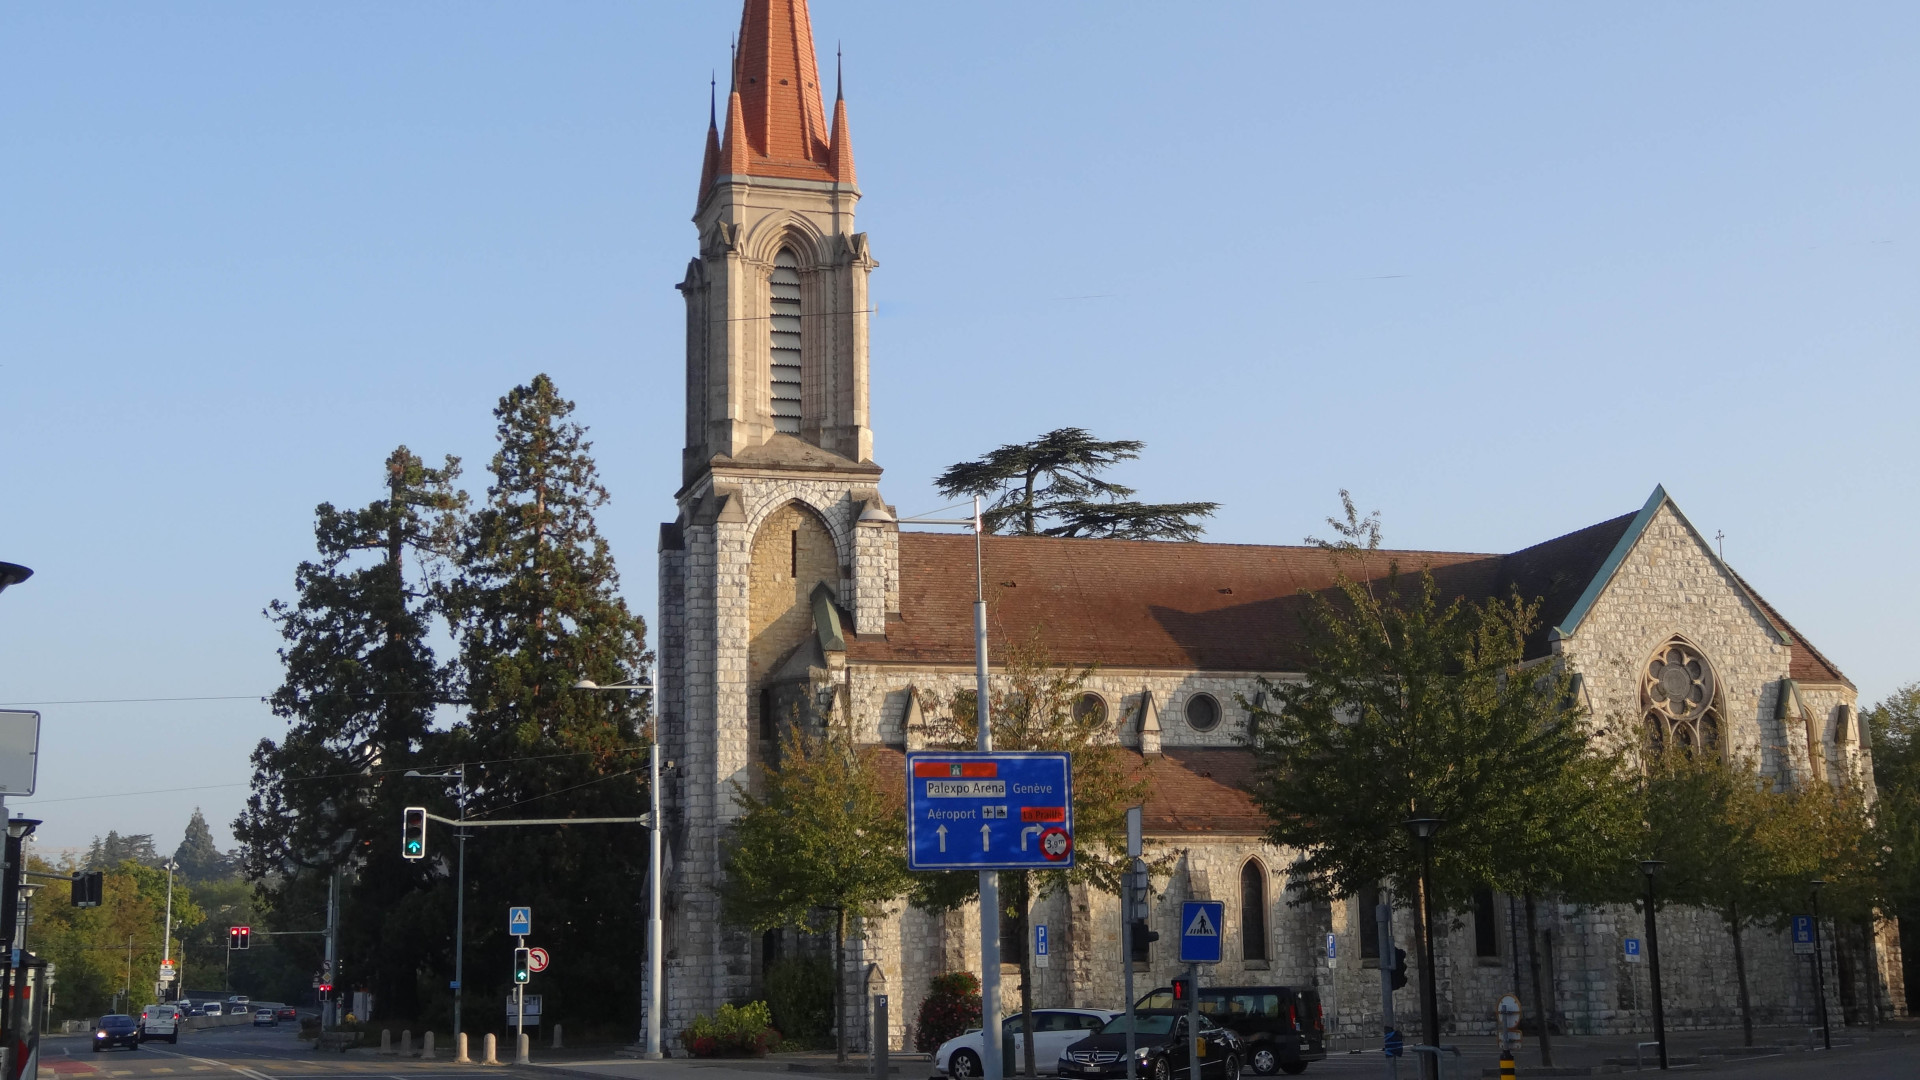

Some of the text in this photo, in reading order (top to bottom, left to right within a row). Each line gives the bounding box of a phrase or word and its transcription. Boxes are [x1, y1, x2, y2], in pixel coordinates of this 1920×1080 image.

[928, 783, 1004, 796] Palexpo Arena
[1013, 783, 1052, 794] Genève
[927, 808, 976, 822] Aéroport
[1798, 918, 1807, 930] P
[1038, 926, 1045, 941] P
[1328, 935, 1334, 947] P
[1628, 941, 1636, 953] P
[880, 997, 886, 1007] P
